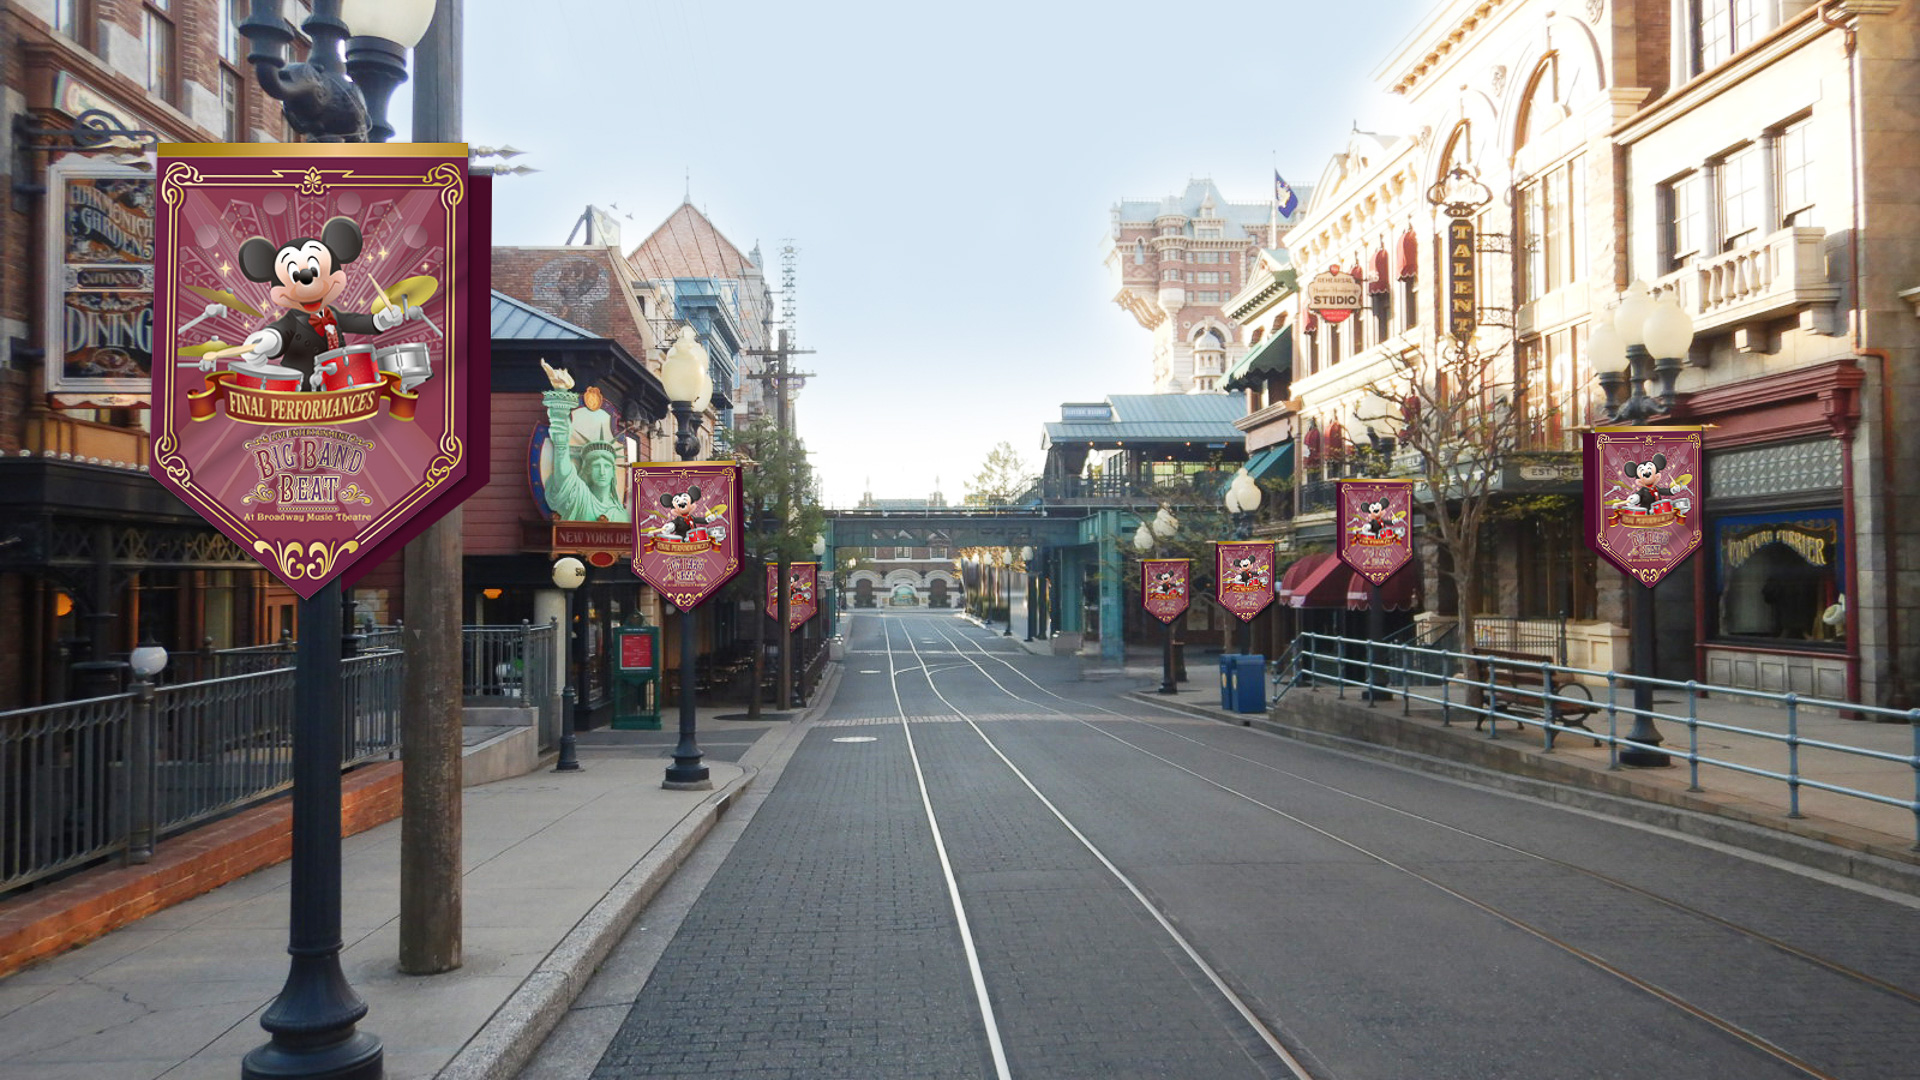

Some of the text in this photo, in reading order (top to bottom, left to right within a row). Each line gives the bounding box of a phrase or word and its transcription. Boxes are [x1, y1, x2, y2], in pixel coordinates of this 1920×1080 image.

[1450, 208, 1471, 216] OF
[80, 207, 154, 260] GARDENS
[81, 271, 140, 285] OUTDOOR
[1452, 225, 1473, 331] TALENT
[1313, 295, 1357, 305] STUDIO
[65, 304, 153, 354] DINING
[228, 390, 376, 420] FINAL PERFORMANCES
[270, 428, 350, 441] LIVE ENTERTAINMENT
[253, 439, 365, 481] BIG BAND
[278, 473, 341, 504] BEAT
[244, 512, 372, 523] At Broadway Music Theatre
[559, 531, 633, 544] NEW YORK DE
[1776, 529, 1827, 566] FURRIER
